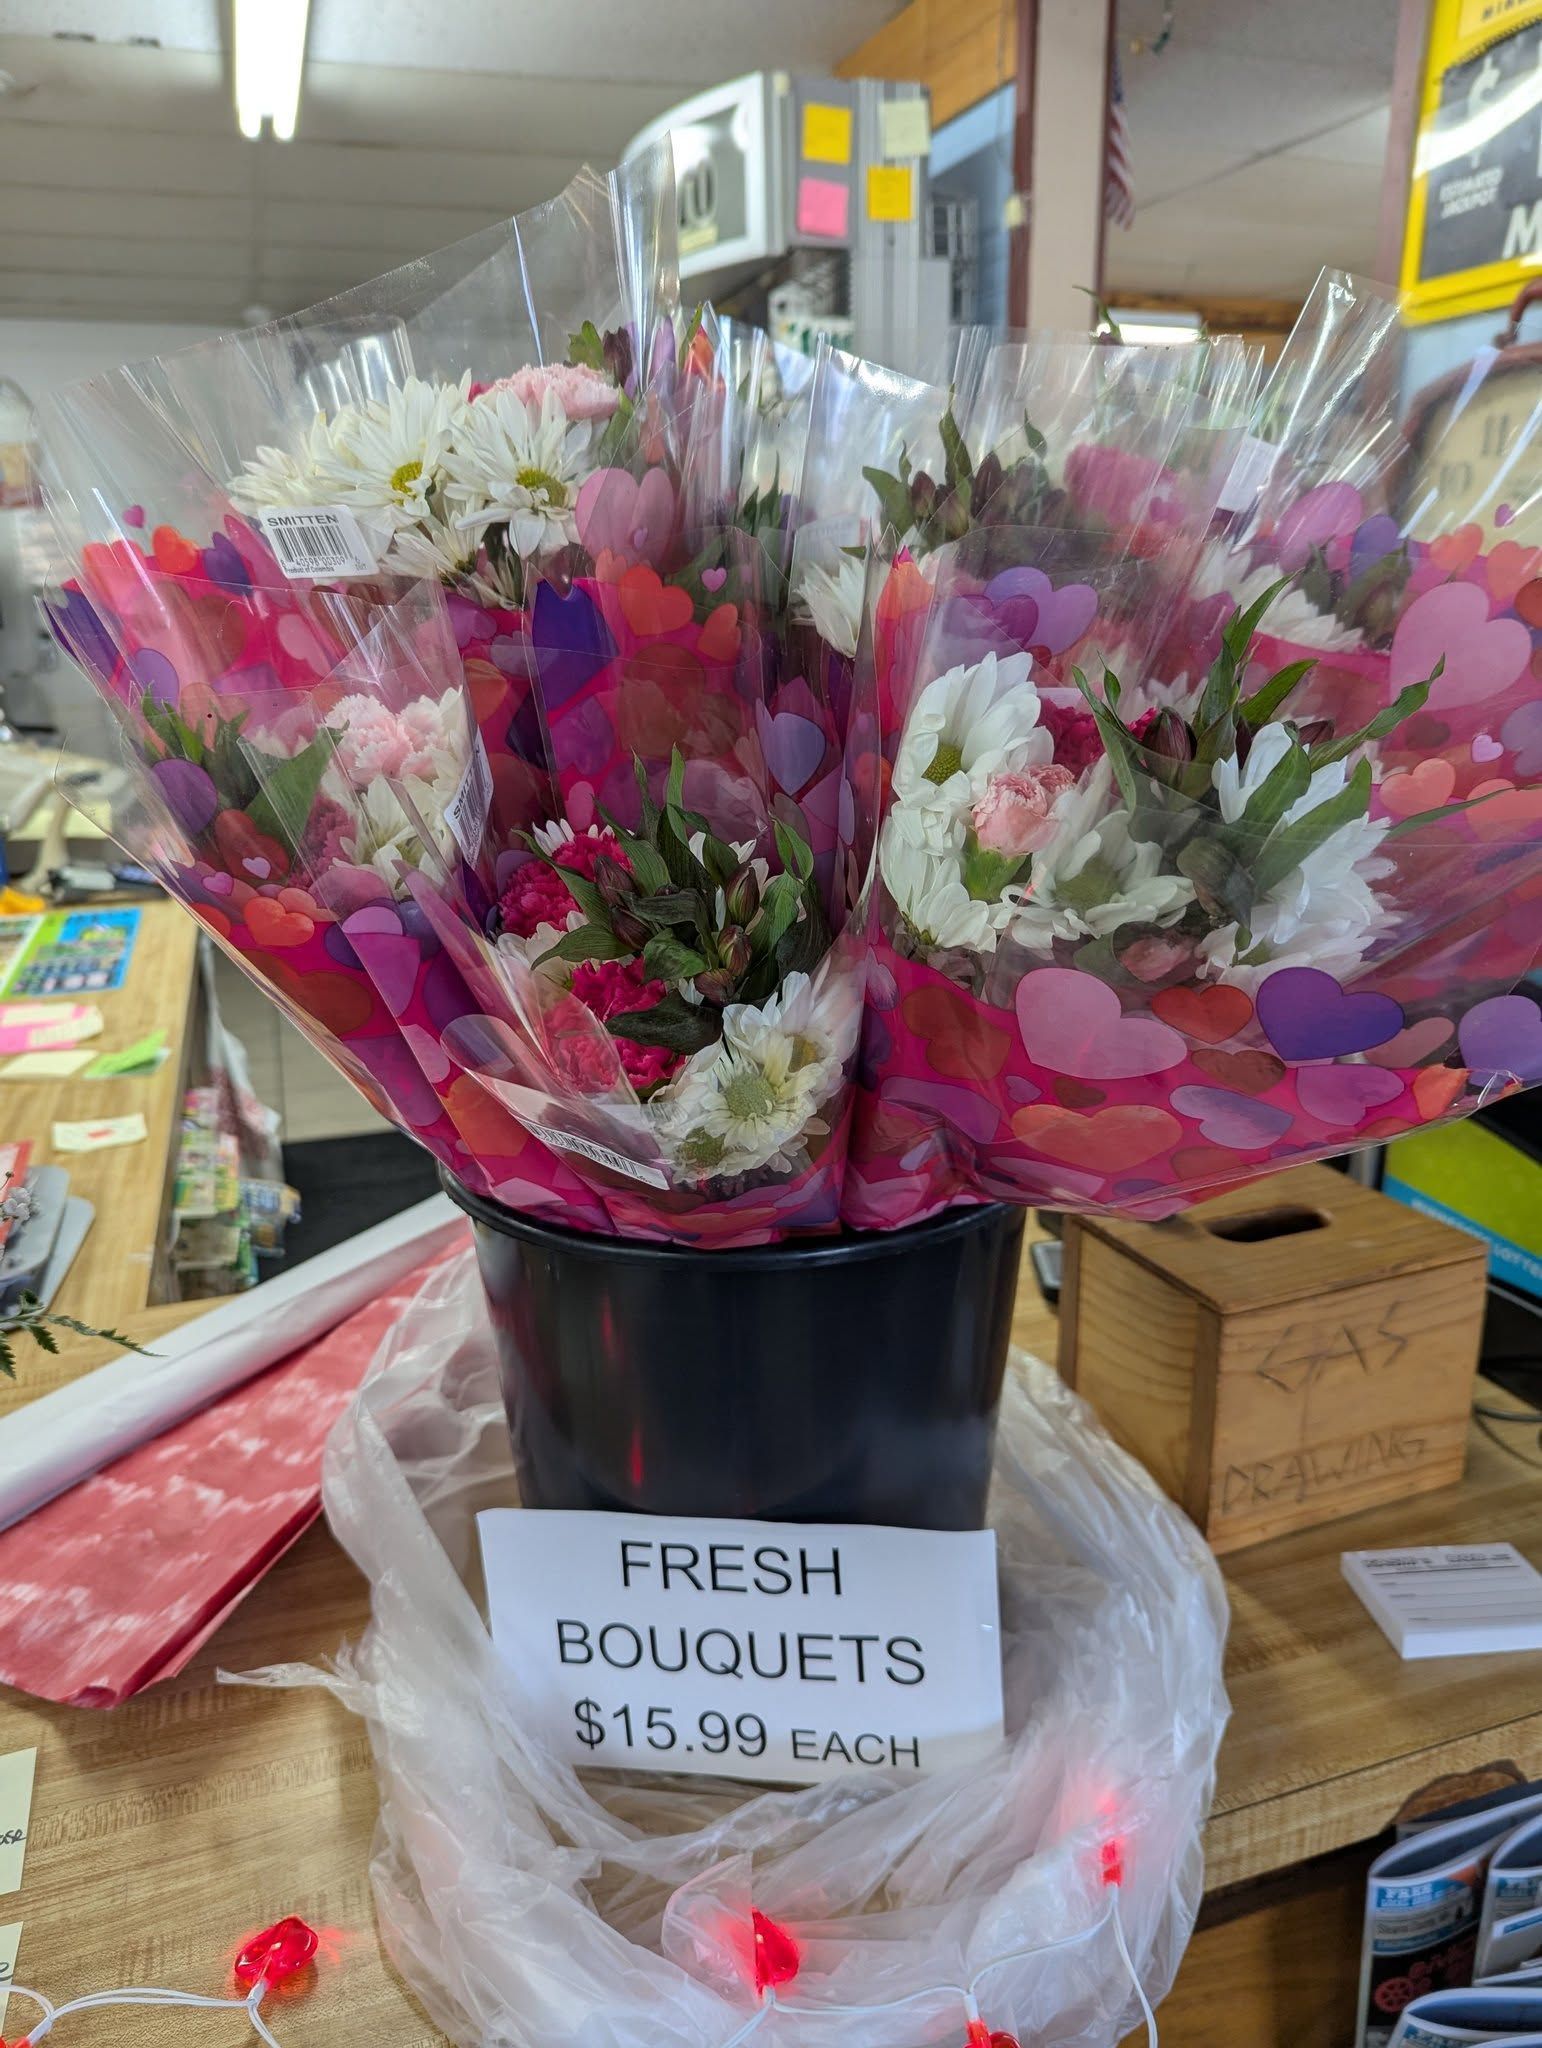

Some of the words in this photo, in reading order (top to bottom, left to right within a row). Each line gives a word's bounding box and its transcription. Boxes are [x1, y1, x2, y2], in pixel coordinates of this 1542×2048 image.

[1441, 185, 1499, 220] JACKPOT
[267, 514, 340, 528] SMITTEN
[1222, 1431, 1427, 1515] DRAWING
[621, 1540, 842, 1595] FRESH
[556, 1618, 925, 1685] BOUQUETS
[574, 1697, 768, 1757] $15.99
[791, 1727, 921, 1768] EACH
